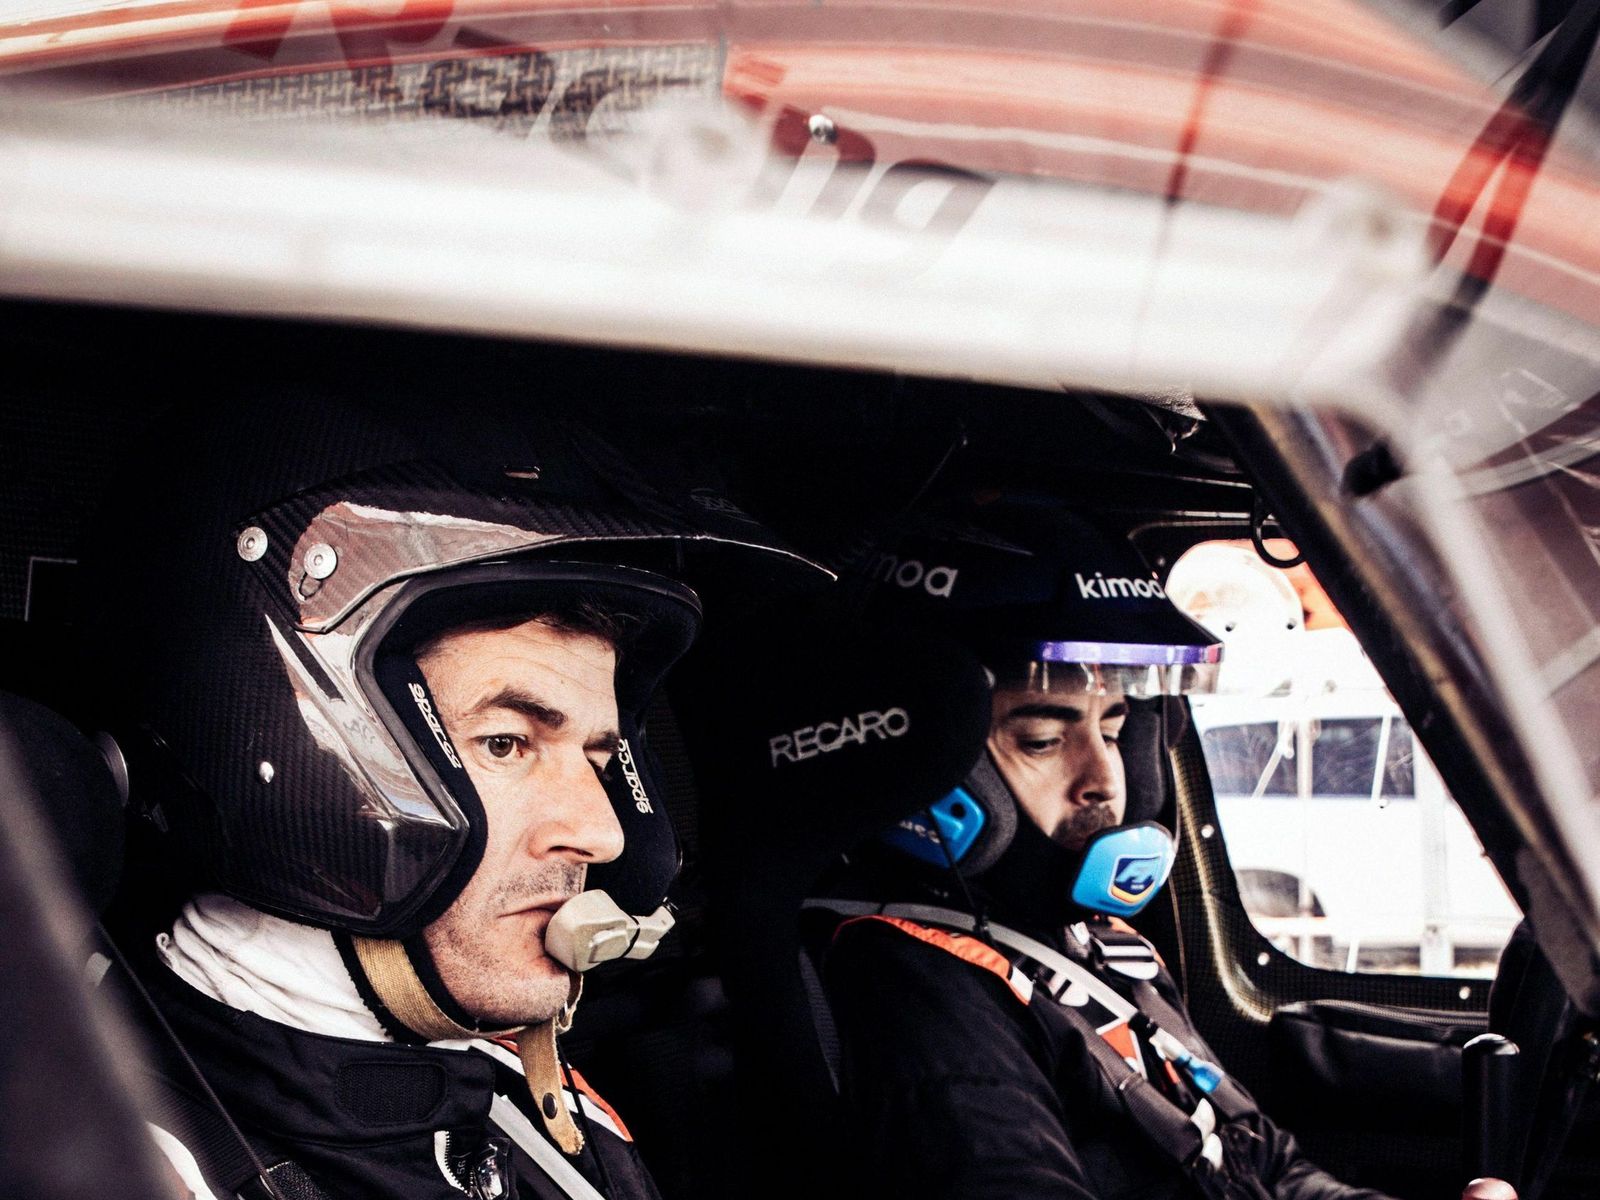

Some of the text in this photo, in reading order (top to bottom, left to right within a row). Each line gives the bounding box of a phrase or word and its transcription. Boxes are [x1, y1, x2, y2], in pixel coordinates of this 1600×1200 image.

[407, 682, 462, 769] sparco
[768, 706, 910, 768] RECARO
[617, 738, 654, 815] sparco
